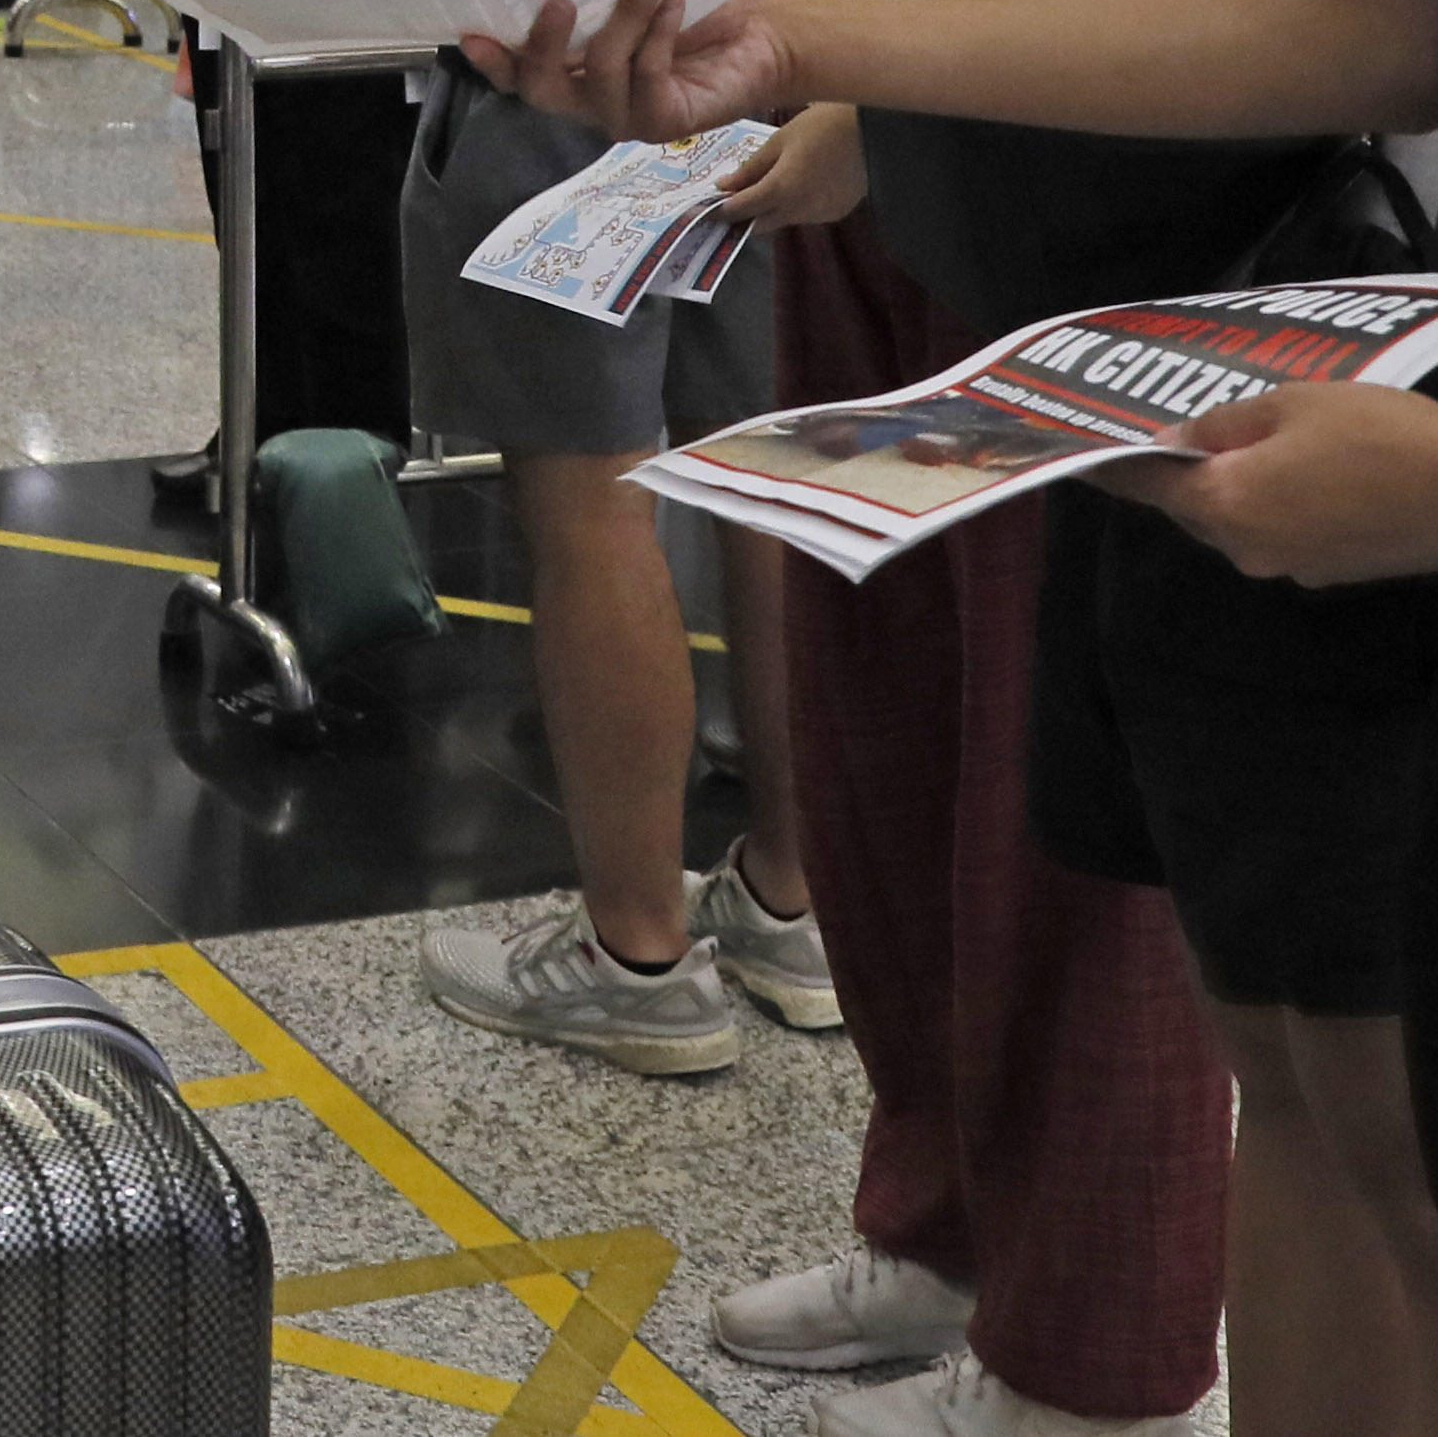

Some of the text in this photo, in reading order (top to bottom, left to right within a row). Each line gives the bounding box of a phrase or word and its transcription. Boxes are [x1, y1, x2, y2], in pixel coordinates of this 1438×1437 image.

[1226, 289, 1438, 335] POLICE
[1016, 326, 1112, 374] HK
[1241, 327, 1361, 383] KILL
[968, 374, 1031, 405] Brutally
